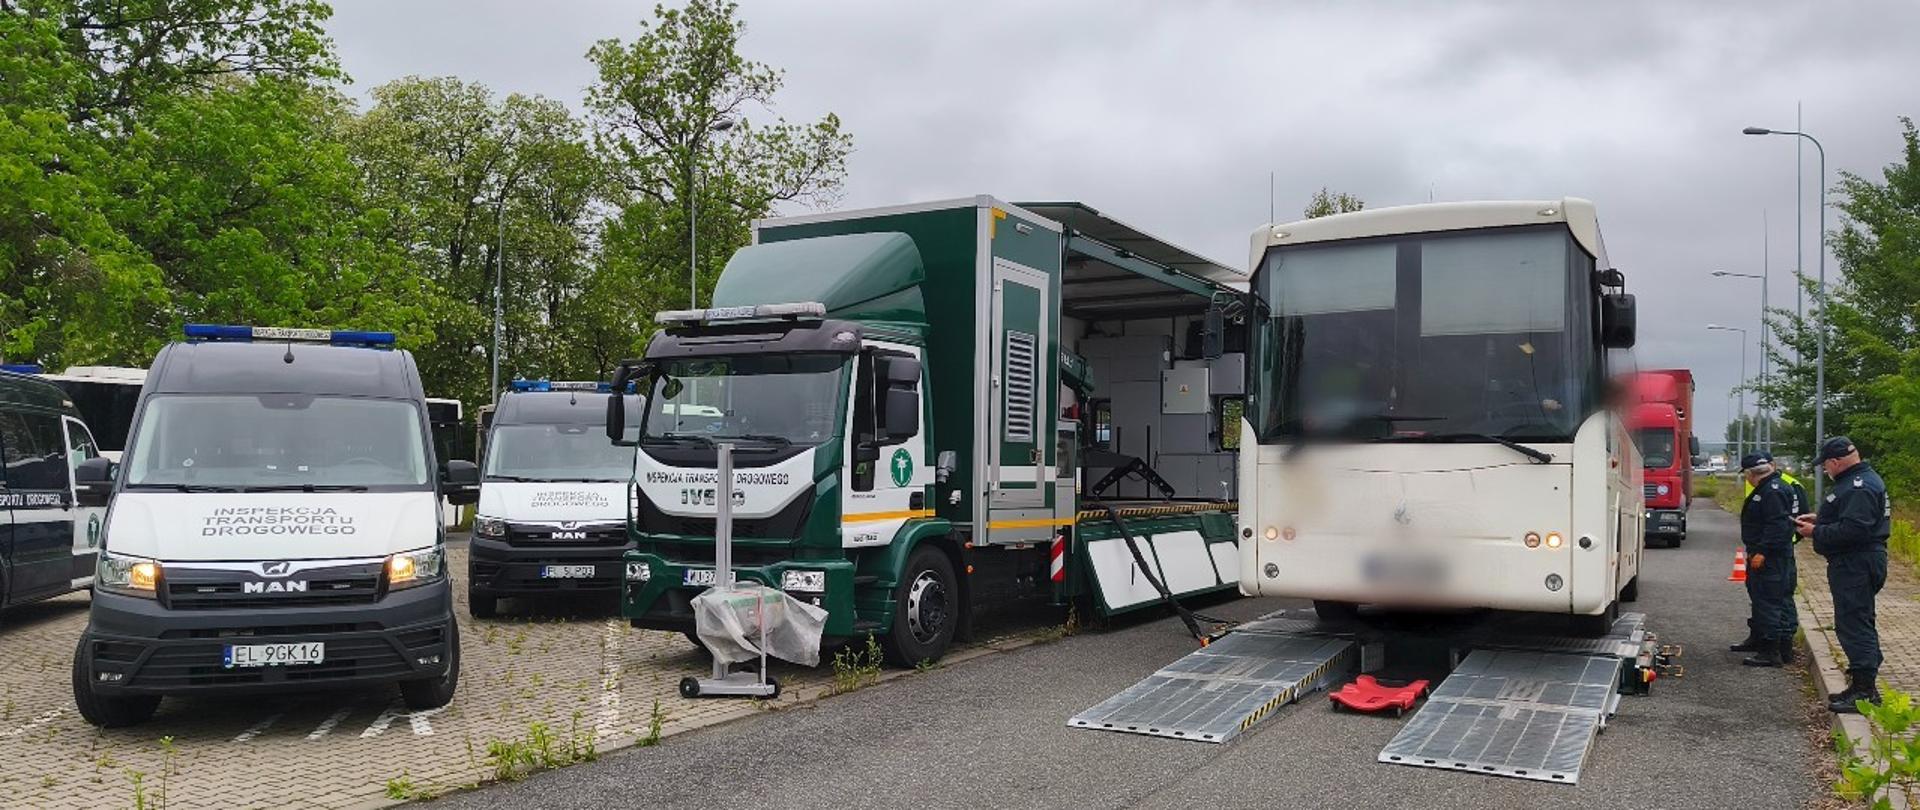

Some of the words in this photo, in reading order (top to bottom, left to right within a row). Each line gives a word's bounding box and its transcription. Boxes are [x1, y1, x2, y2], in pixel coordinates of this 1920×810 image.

[736, 473, 789, 485] DROGOWEGO
[681, 488, 746, 506] IVEO
[214, 507, 337, 516] INSPEKCJA
[203, 515, 353, 526] TRANSPORTU
[202, 525, 356, 537] DROGOWEGO
[552, 531, 587, 540] MAN
[244, 580, 307, 594] MAN
[235, 646, 257, 663] EL
[265, 643, 319, 662] 9GK16
